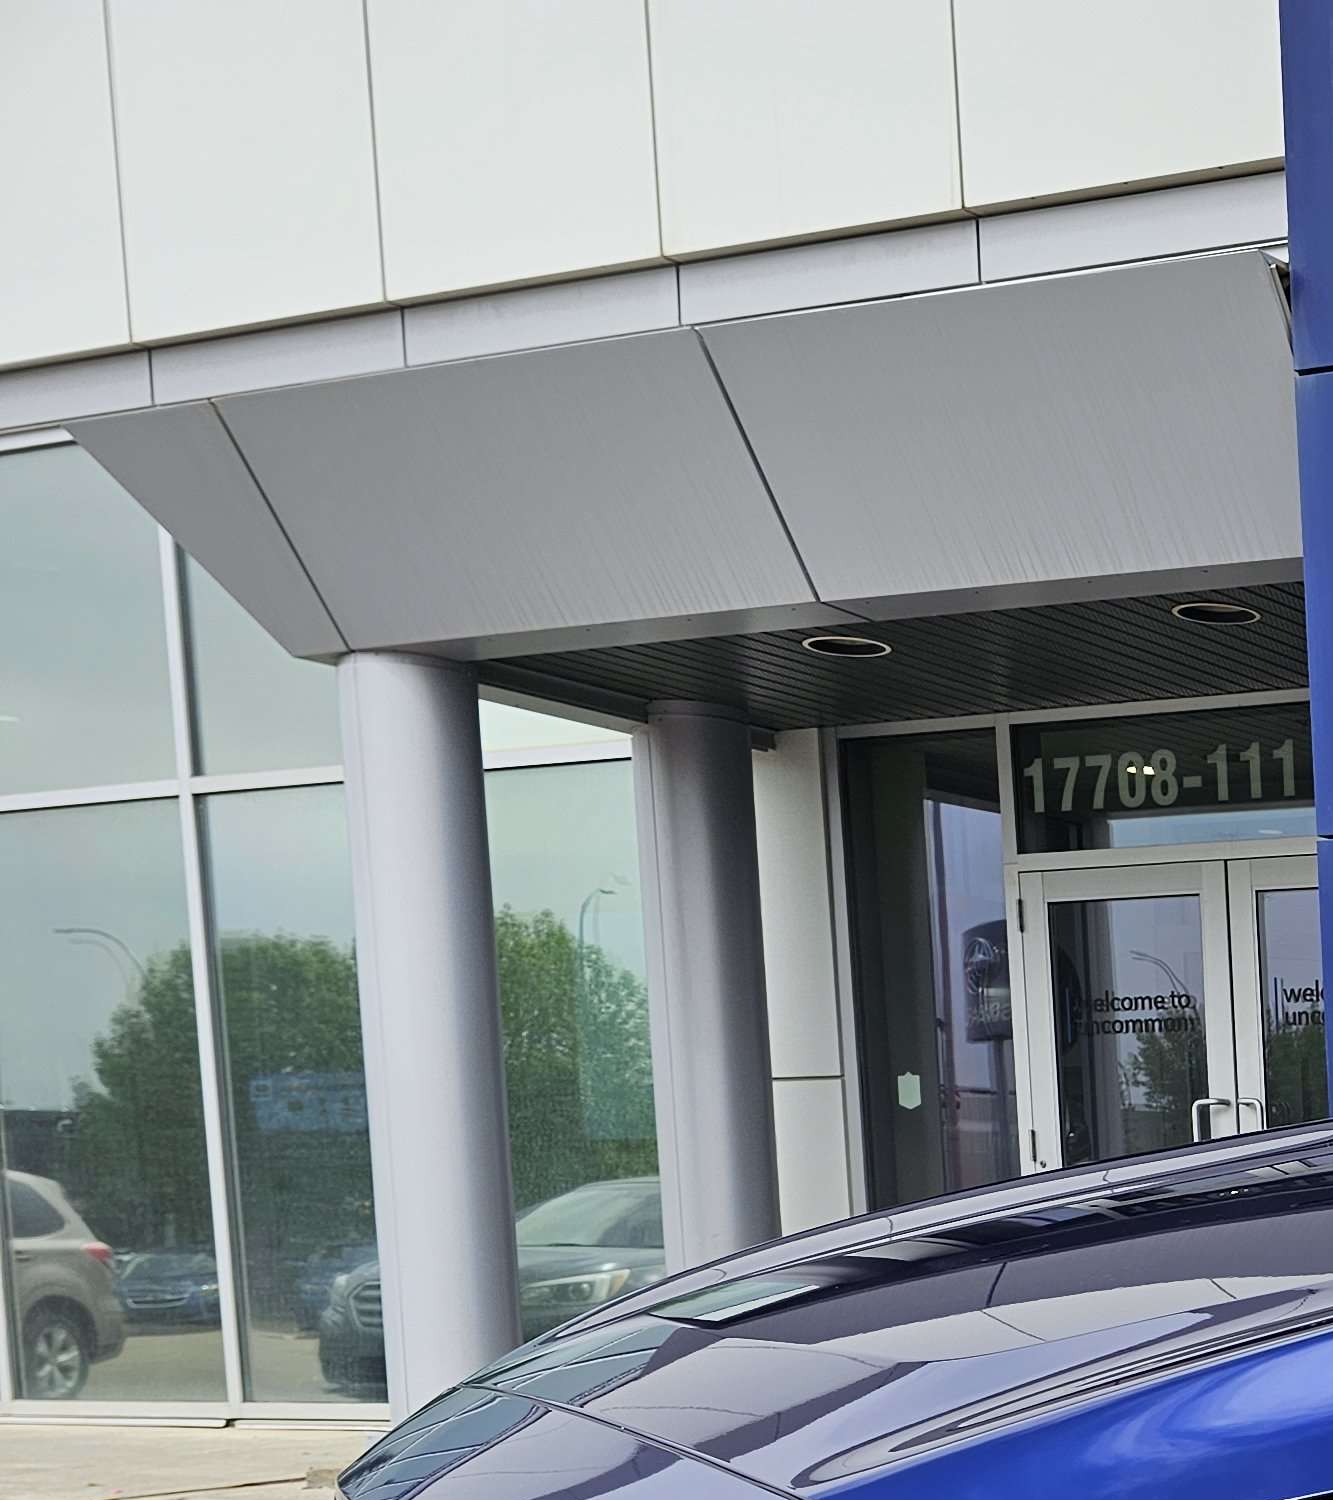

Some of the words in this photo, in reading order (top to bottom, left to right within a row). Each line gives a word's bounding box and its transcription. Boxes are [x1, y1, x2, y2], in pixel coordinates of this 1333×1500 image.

[1023, 738, 1296, 813] 17708-111
[1169, 990, 1191, 1009] to
[1283, 979, 1325, 1003] wel
